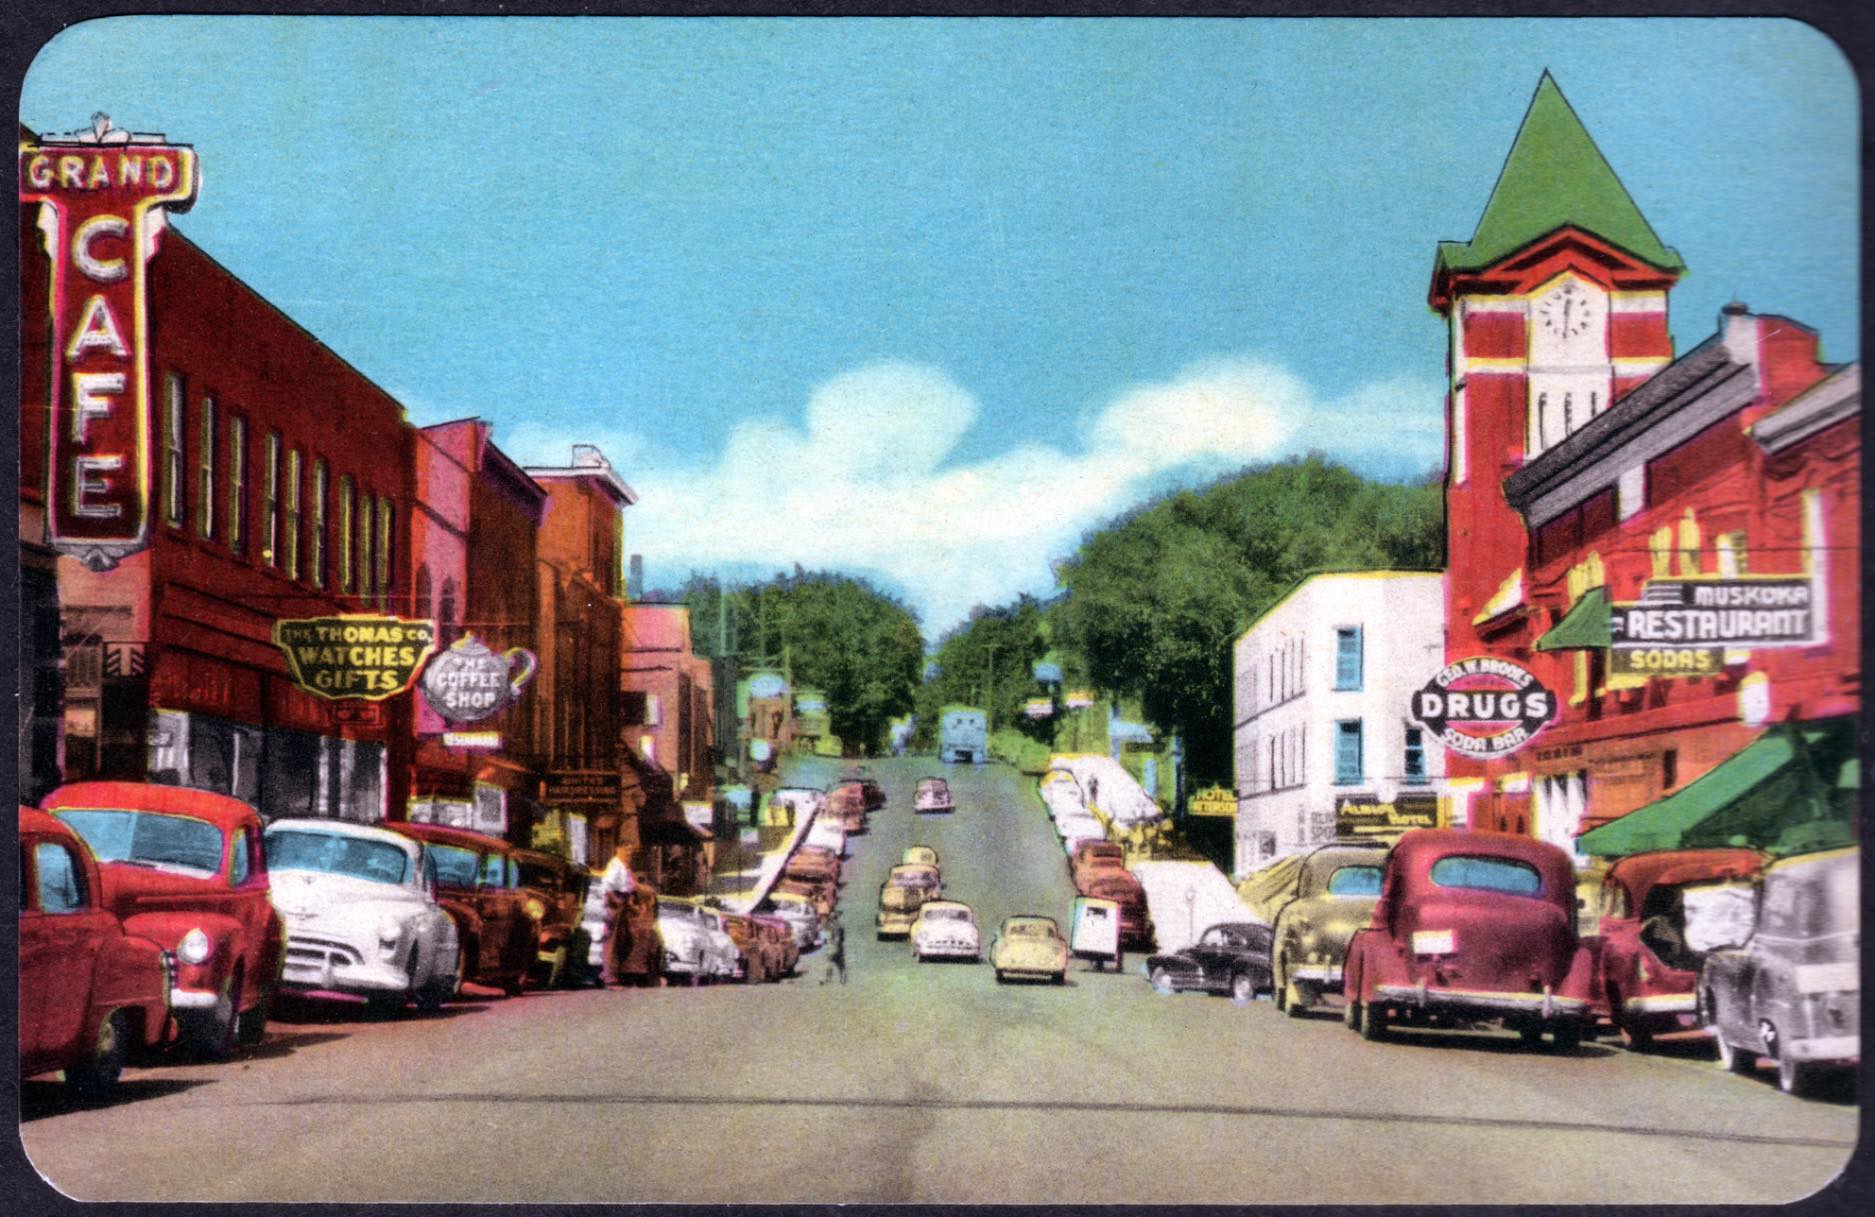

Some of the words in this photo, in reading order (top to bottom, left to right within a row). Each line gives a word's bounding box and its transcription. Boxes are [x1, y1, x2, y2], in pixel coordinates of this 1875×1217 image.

[28, 153, 174, 190] GRAND
[67, 214, 131, 518] CAFE
[1694, 586, 1808, 605] MUSKOKA
[316, 626, 403, 643] THOMAS
[1628, 609, 1808, 639] RESTAURANT
[299, 646, 416, 667] WATCHES
[1630, 650, 1712, 669] SODAS
[315, 669, 399, 690] GIFTS
[437, 672, 500, 688] COFFEE
[444, 691, 496, 709] SHOP
[1421, 692, 1549, 719] DRUGS
